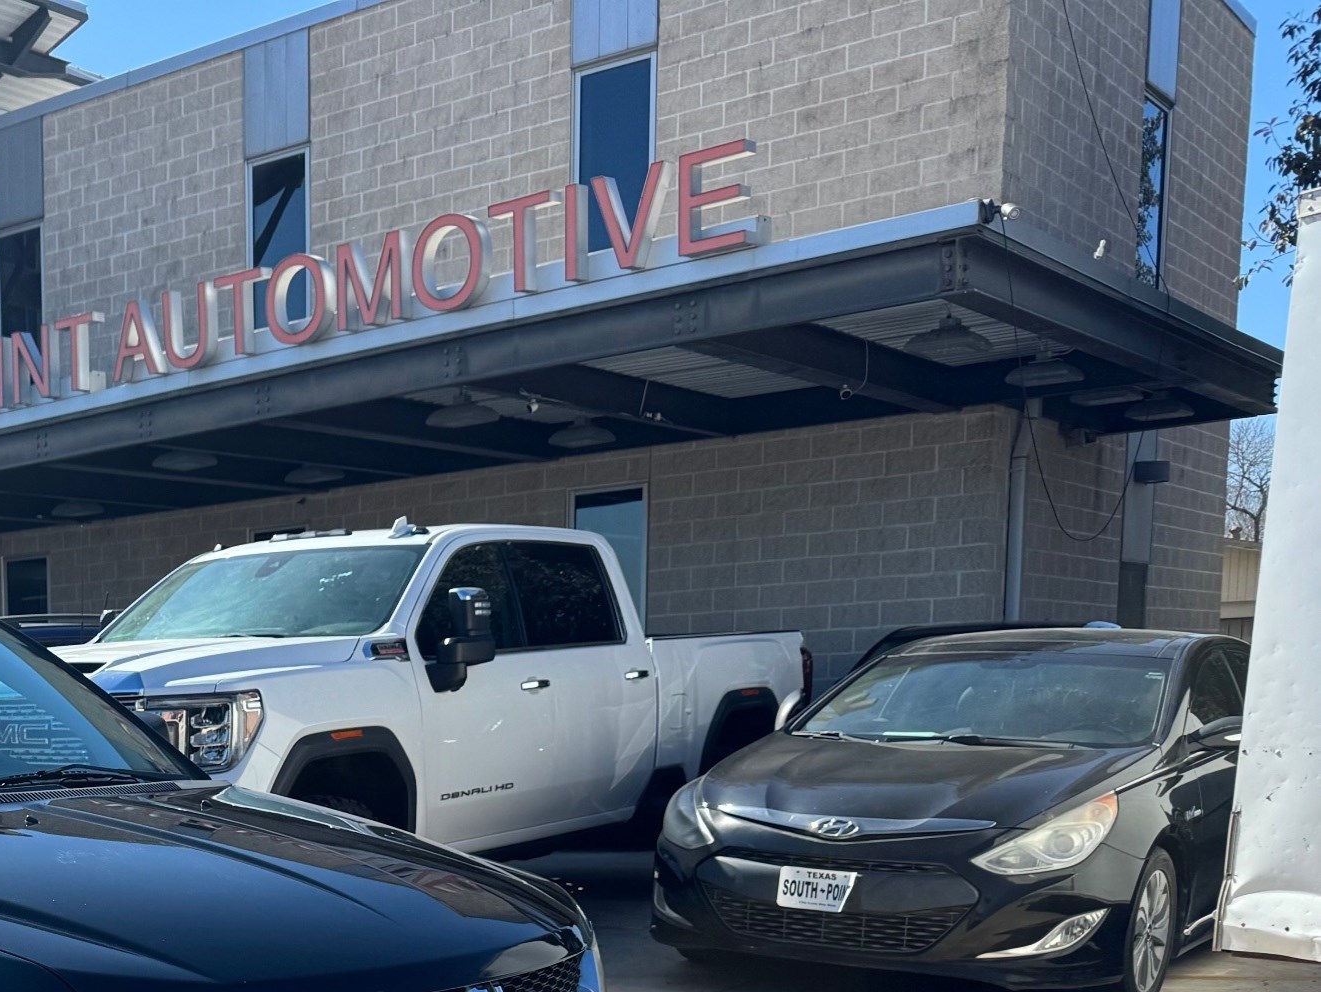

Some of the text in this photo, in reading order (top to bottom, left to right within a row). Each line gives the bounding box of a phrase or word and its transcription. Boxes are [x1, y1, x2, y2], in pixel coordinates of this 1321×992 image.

[114, 139, 756, 382] AUTOMOTIVE
[440, 782, 514, 800] DENALI HD
[807, 871, 837, 880] TEXAS
[783, 879, 818, 898] SOUTH
